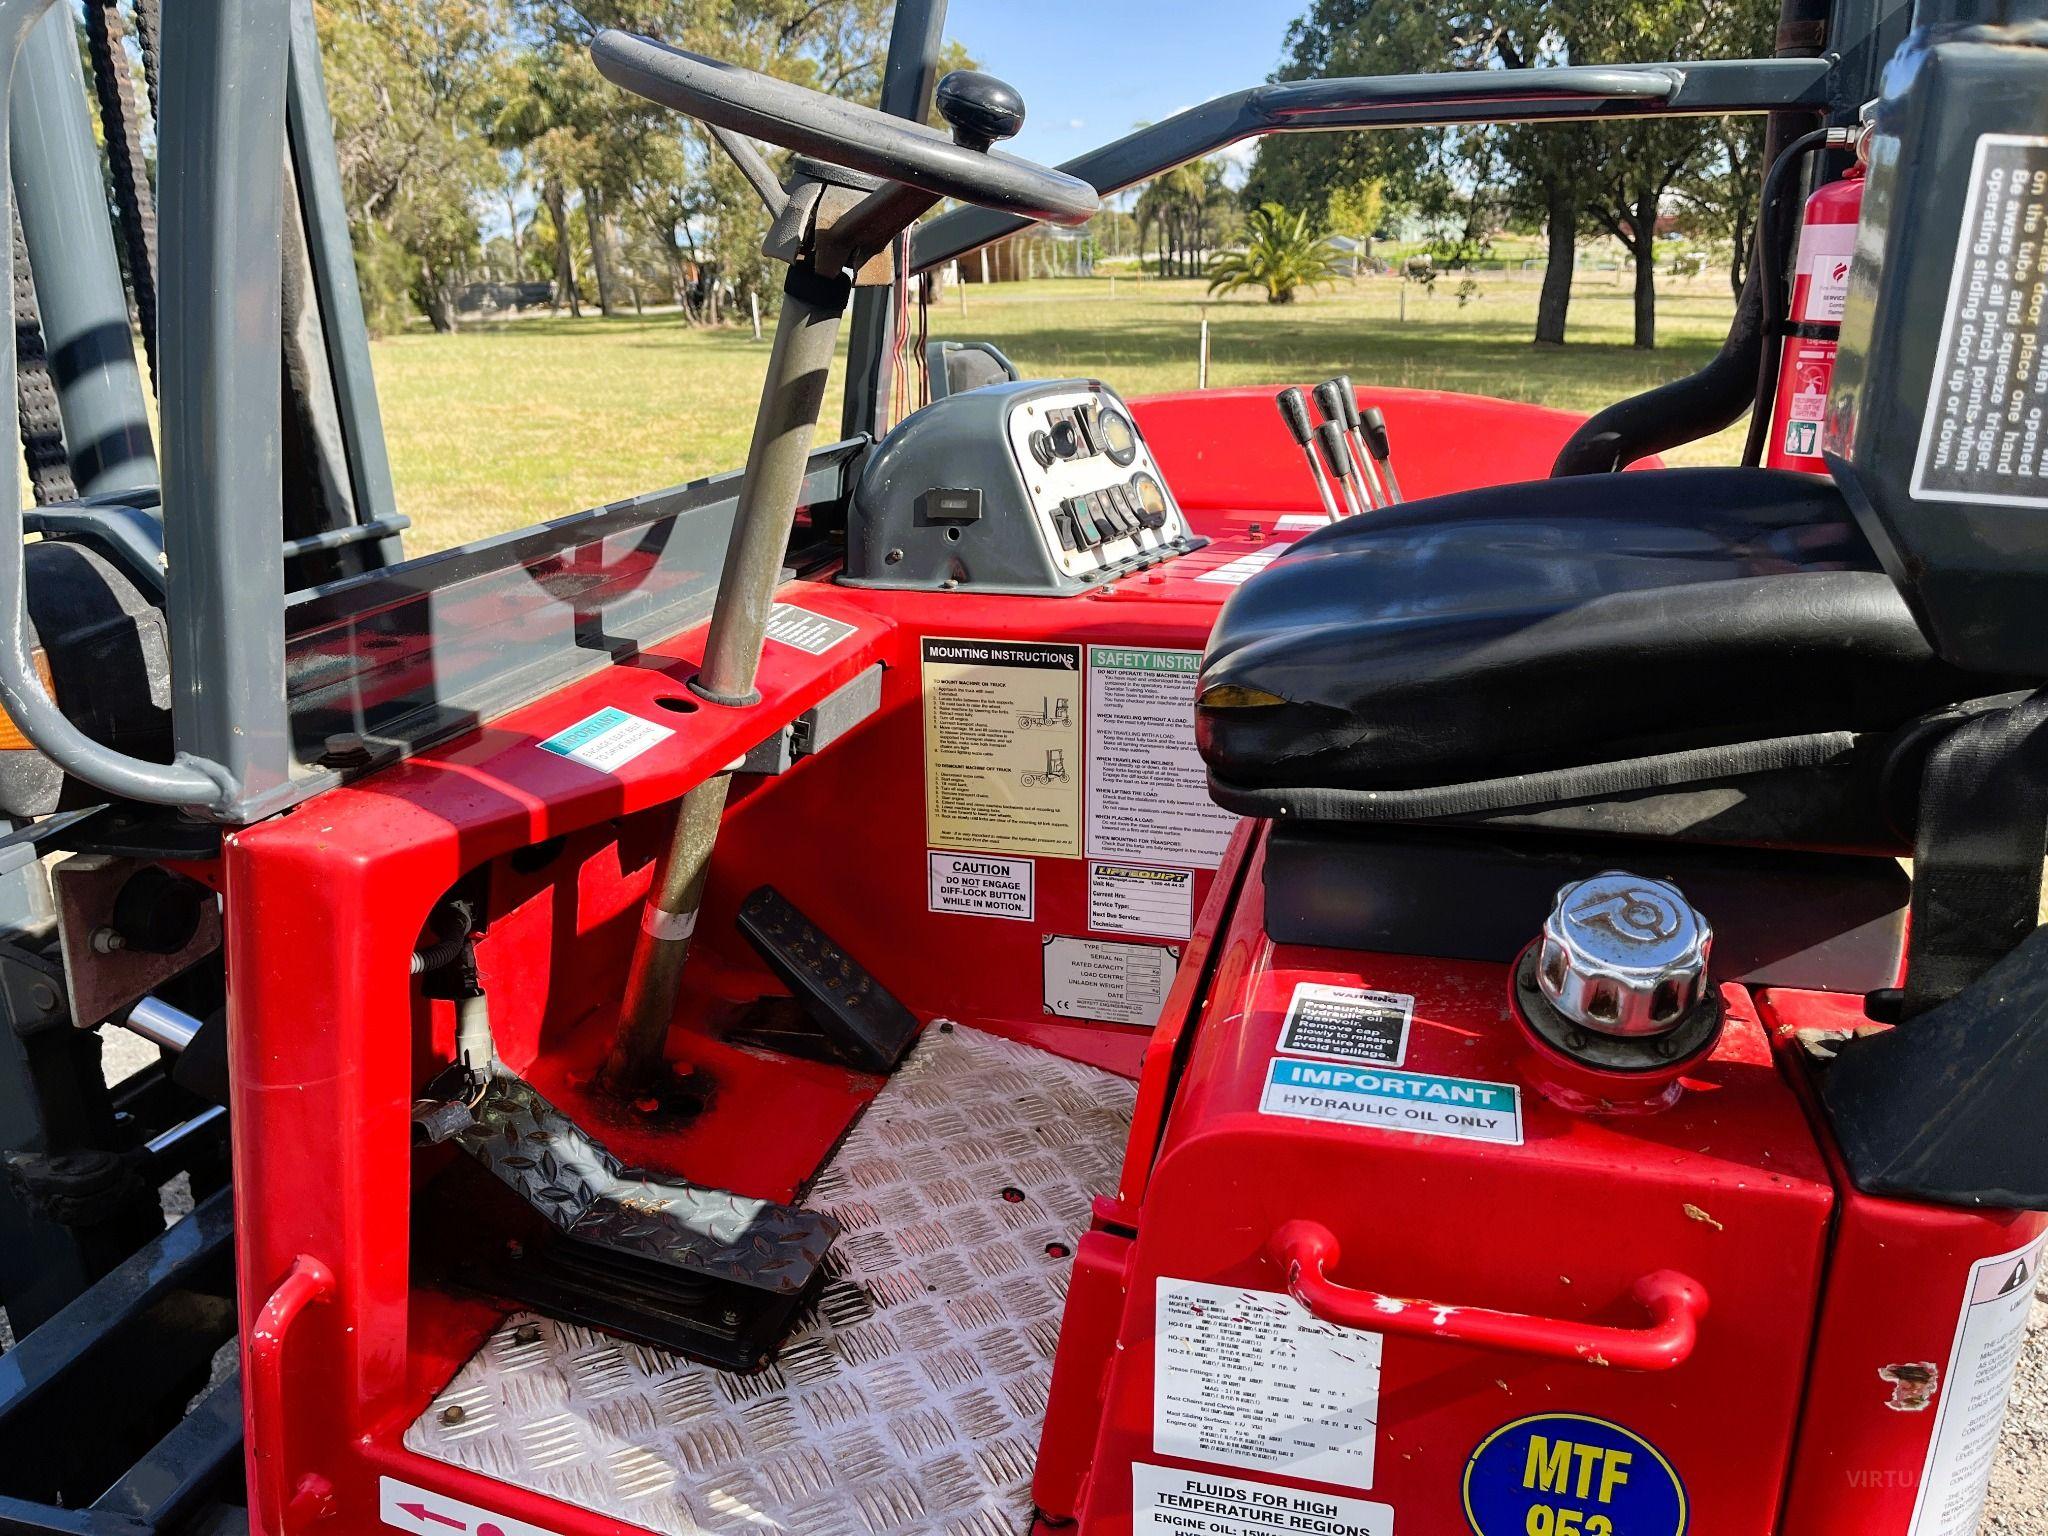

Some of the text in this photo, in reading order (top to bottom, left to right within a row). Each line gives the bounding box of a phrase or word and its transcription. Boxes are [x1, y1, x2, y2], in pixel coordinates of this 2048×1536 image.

[2009, 169, 2030, 195] Be
[1998, 200, 2020, 255] aware
[1993, 259, 2009, 280] of
[1988, 283, 2005, 306] all
[2028, 283, 2048, 326] door
[1934, 168, 2004, 469] operating sliding door up or down.
[1976, 170, 2047, 472] on the tube and squeeze trigger.
[1978, 311, 2000, 360] pinch
[2016, 333, 2037, 380] place
[2008, 389, 2024, 422] one
[1955, 425, 1975, 471] when
[2017, 408, 2042, 475] opened
[1997, 432, 2020, 474] hand
[929, 647, 1074, 665] MOUNTING INSTRUCTIONS
[1097, 652, 1150, 668] SAFETY
[555, 714, 621, 749] IMPORTANT
[953, 862, 1010, 876] CAUTION
[947, 876, 1021, 890] DO NOT ENGAGE
[941, 887, 1026, 901] DIFF-LOCK BUTTON
[943, 897, 971, 906] WHILE
[985, 901, 1024, 912] MOTION.
[1093, 900, 1113, 908] Service
[1093, 921, 1124, 929] Technician:
[1094, 963, 1124, 971] CAPACITY
[1068, 979, 1124, 990] UNLADEN WEIGHT
[1099, 973, 1124, 981] CENTRE
[1333, 991, 1398, 1004] WARNING
[1303, 1007, 1363, 1020] hydraulic
[1305, 1001, 1382, 1016] Pressurized
[1299, 1021, 1381, 1037] Remove cap
[1301, 1014, 1362, 1027] reservoir.
[1294, 1034, 1383, 1051] pressure and
[1297, 1027, 1394, 1045] slowly to release
[1292, 1042, 1390, 1059] avoid spillage.
[1291, 1066, 1498, 1105] IMPORTANT
[1284, 1093, 1499, 1130] HYDRAULIC OIL ONLY
[1182, 1397, 1203, 1405] Chains
[1166, 1418, 1187, 1427] Engine
[1182, 1413, 1203, 1421] Sliding
[1523, 1434, 1632, 1503] MTF
[1186, 1480, 1337, 1516] FLUIDS FOR HIGH
[1157, 1492, 1370, 1536] TEMPERATURE REGIONS
[1154, 1513, 1206, 1530] ENGINE
[1210, 1523, 1237, 1535] OIL:
